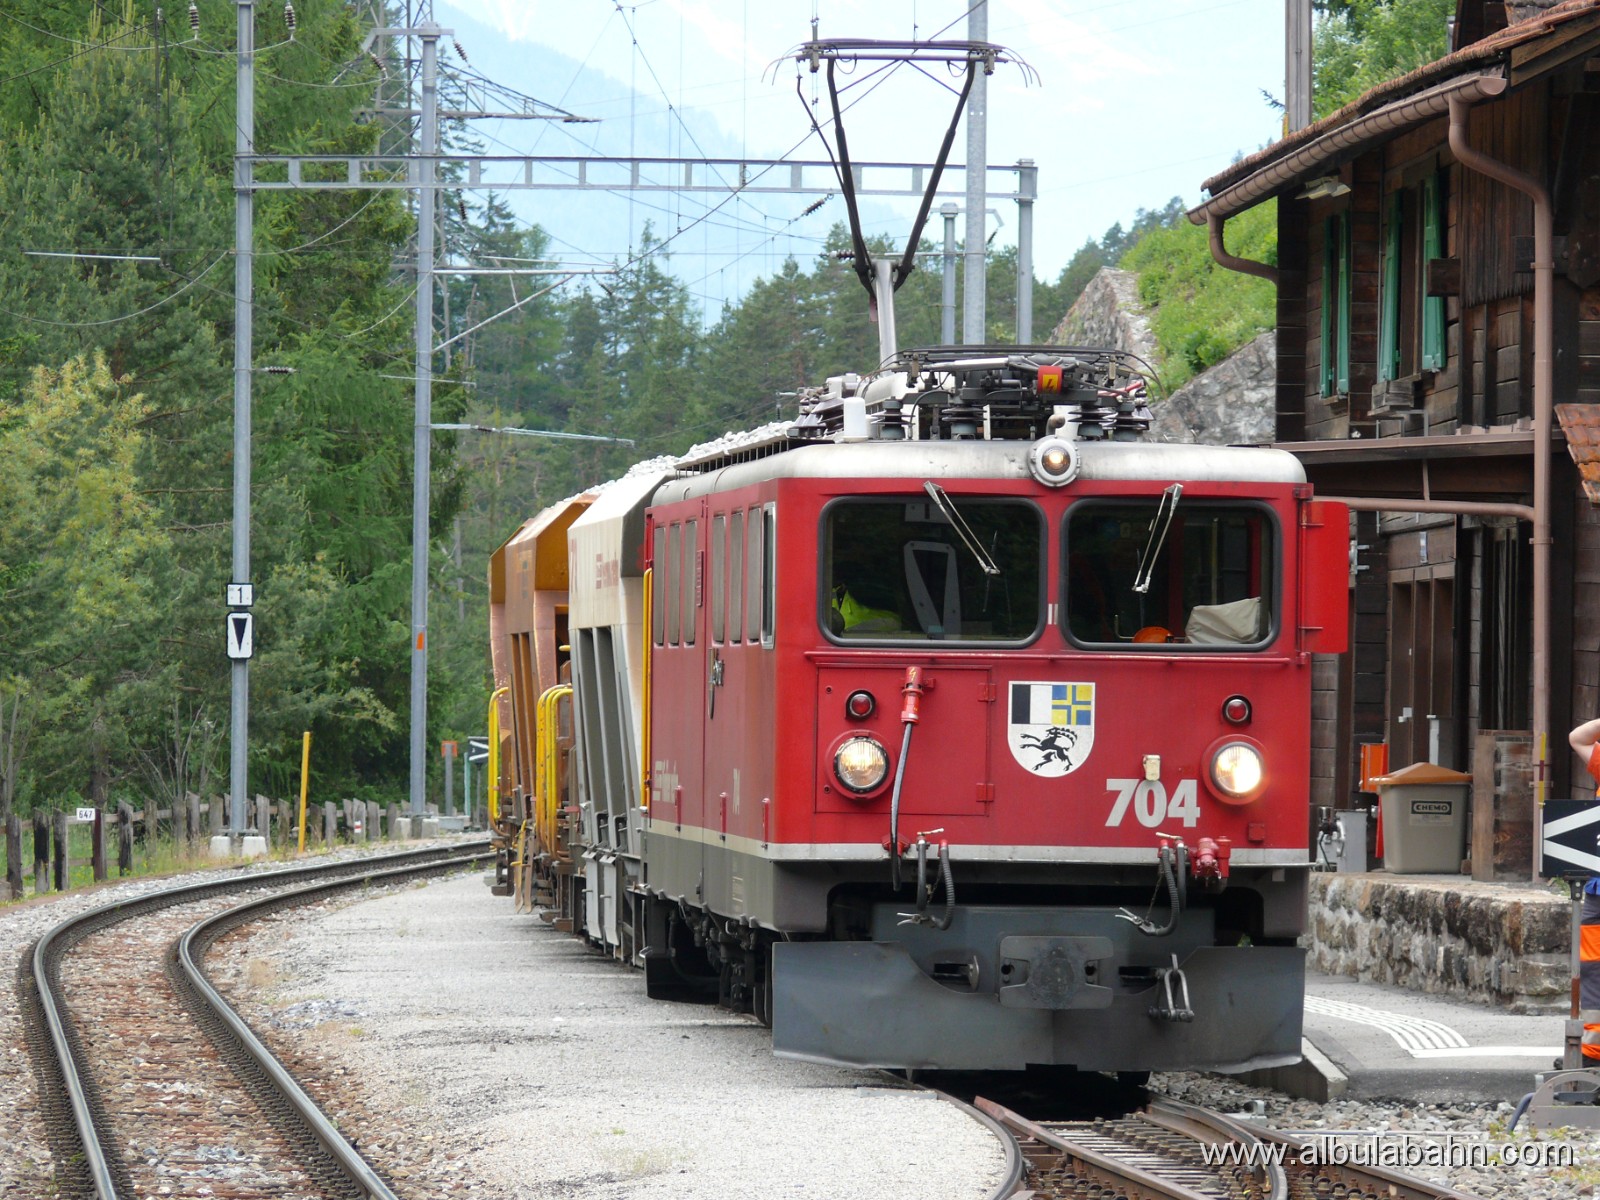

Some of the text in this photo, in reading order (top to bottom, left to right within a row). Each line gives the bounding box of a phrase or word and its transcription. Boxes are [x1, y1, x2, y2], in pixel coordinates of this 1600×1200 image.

[237, 585, 243, 604] 1
[1104, 778, 1201, 828] 704
[1415, 804, 1449, 812] CHEMO
